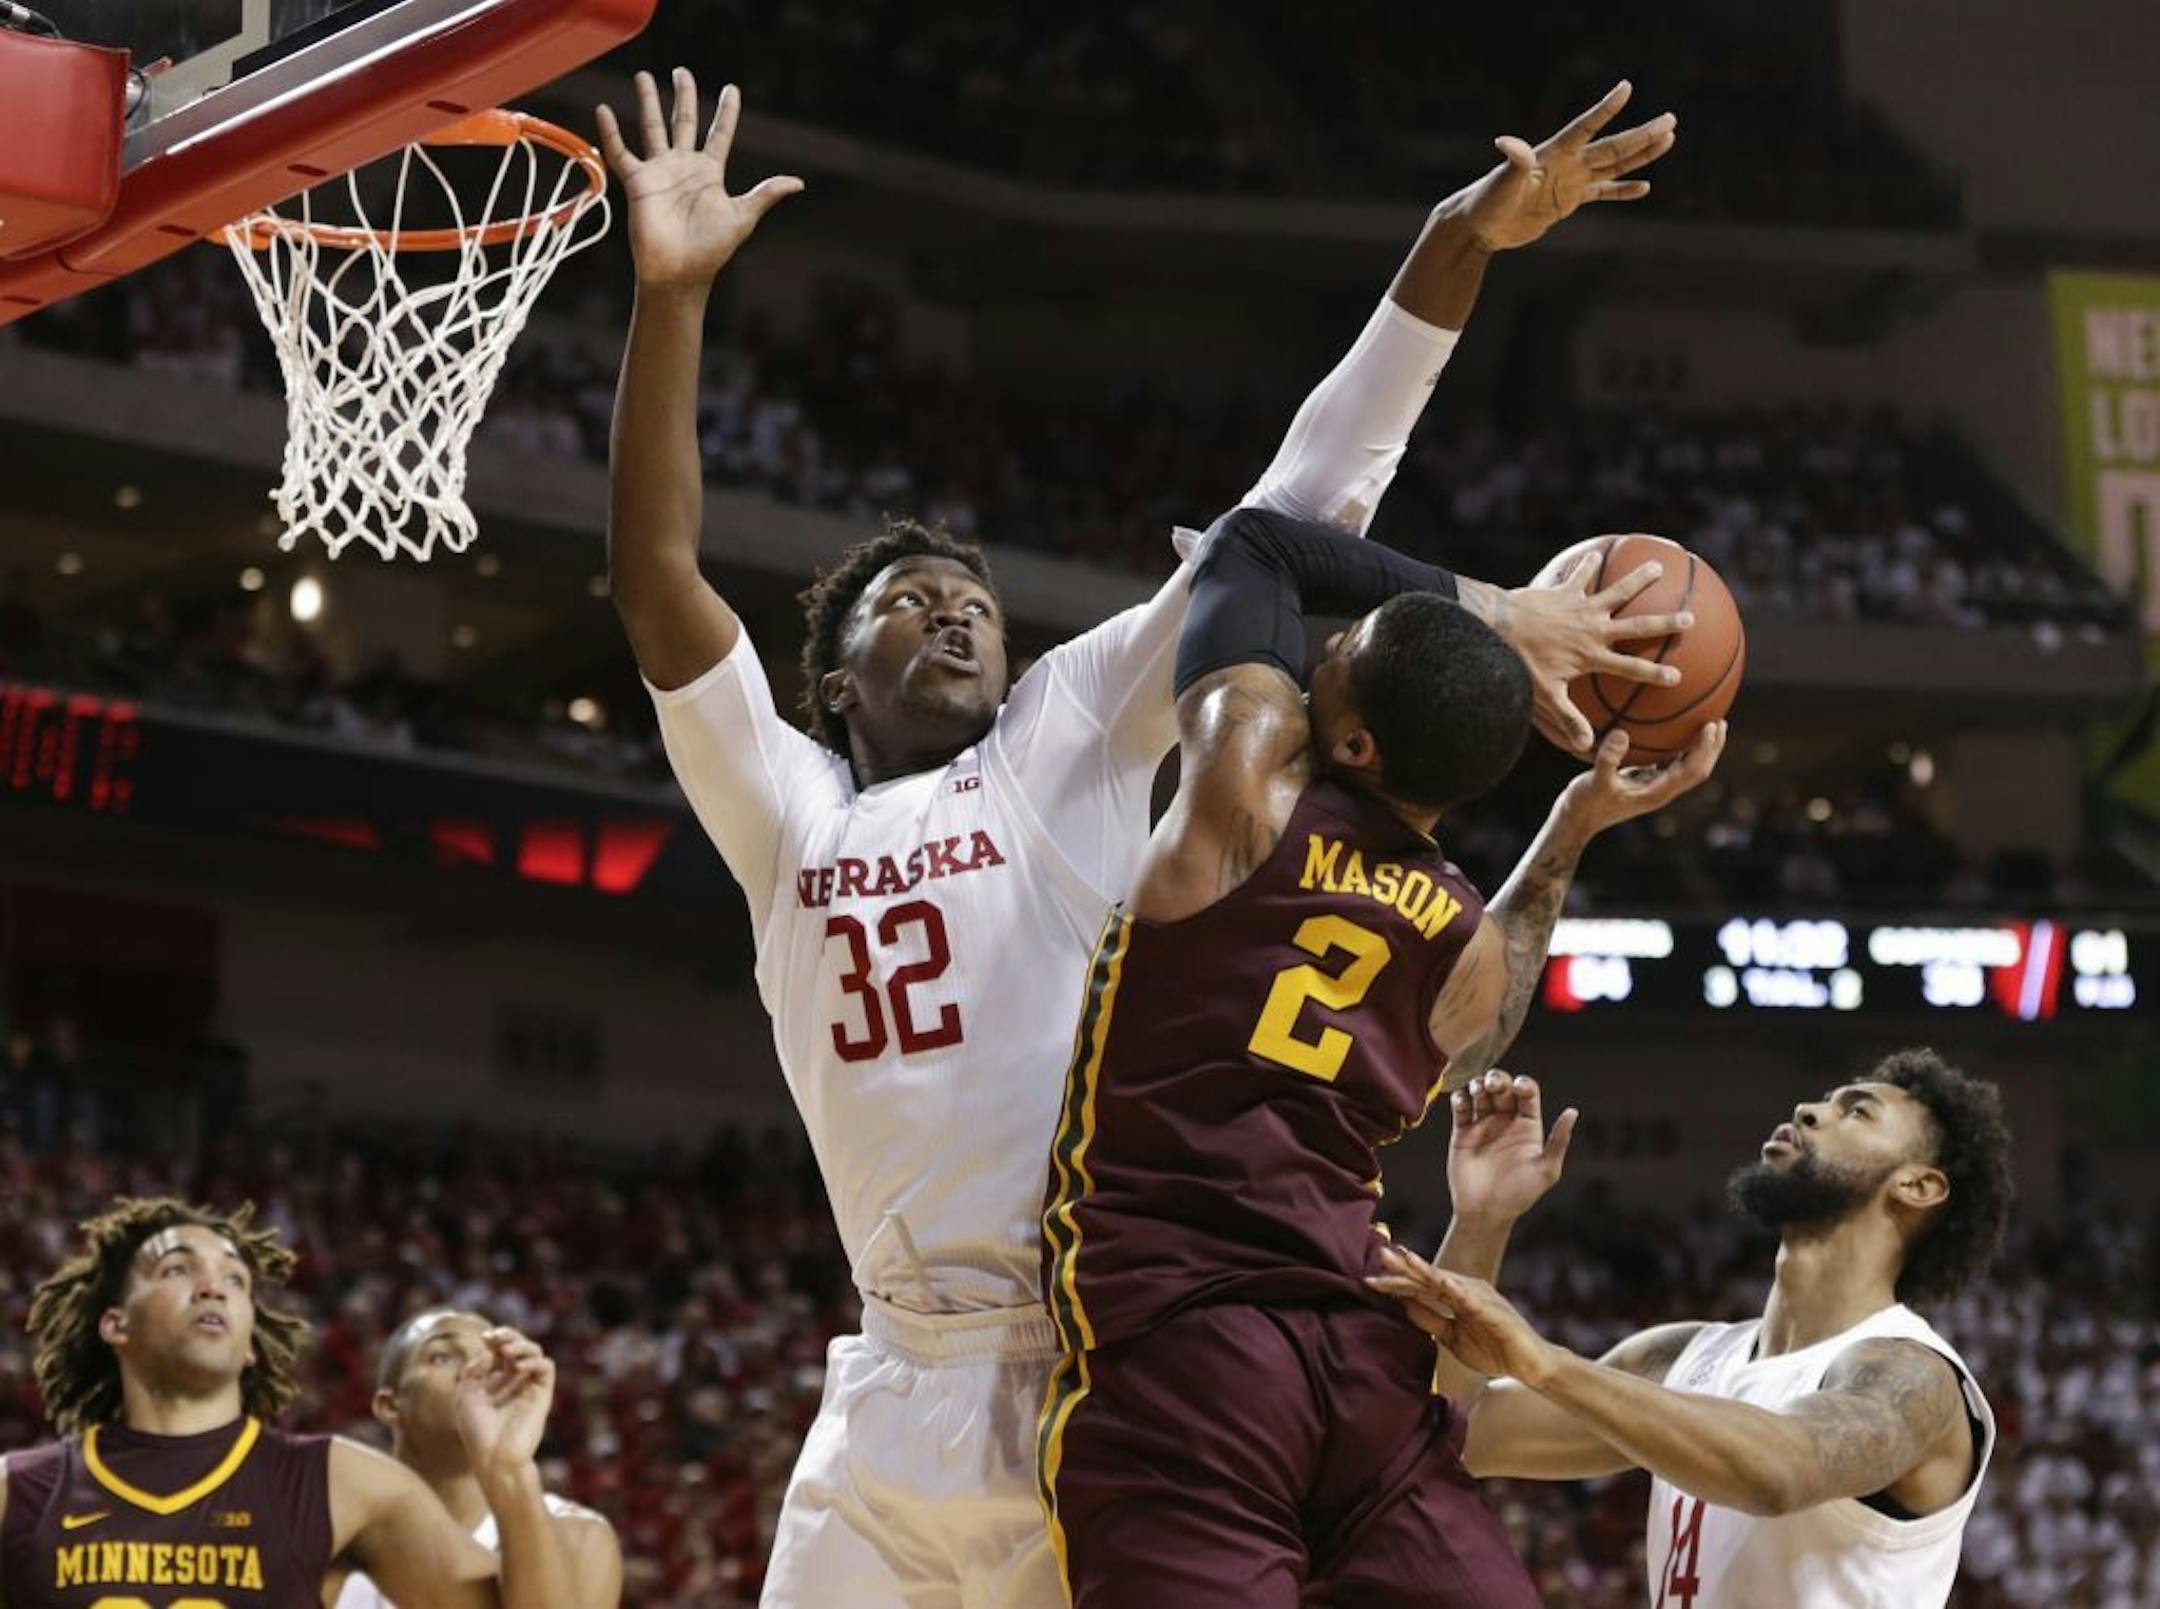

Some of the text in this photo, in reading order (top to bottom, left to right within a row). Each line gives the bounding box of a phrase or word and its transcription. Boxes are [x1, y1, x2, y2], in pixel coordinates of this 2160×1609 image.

[797, 830, 1005, 907] NERASKA
[1300, 834, 1462, 940] MASON
[826, 899, 963, 1062] 32
[1248, 914, 1391, 1081] 2
[56, 1541, 263, 1590] MINNESOTA
